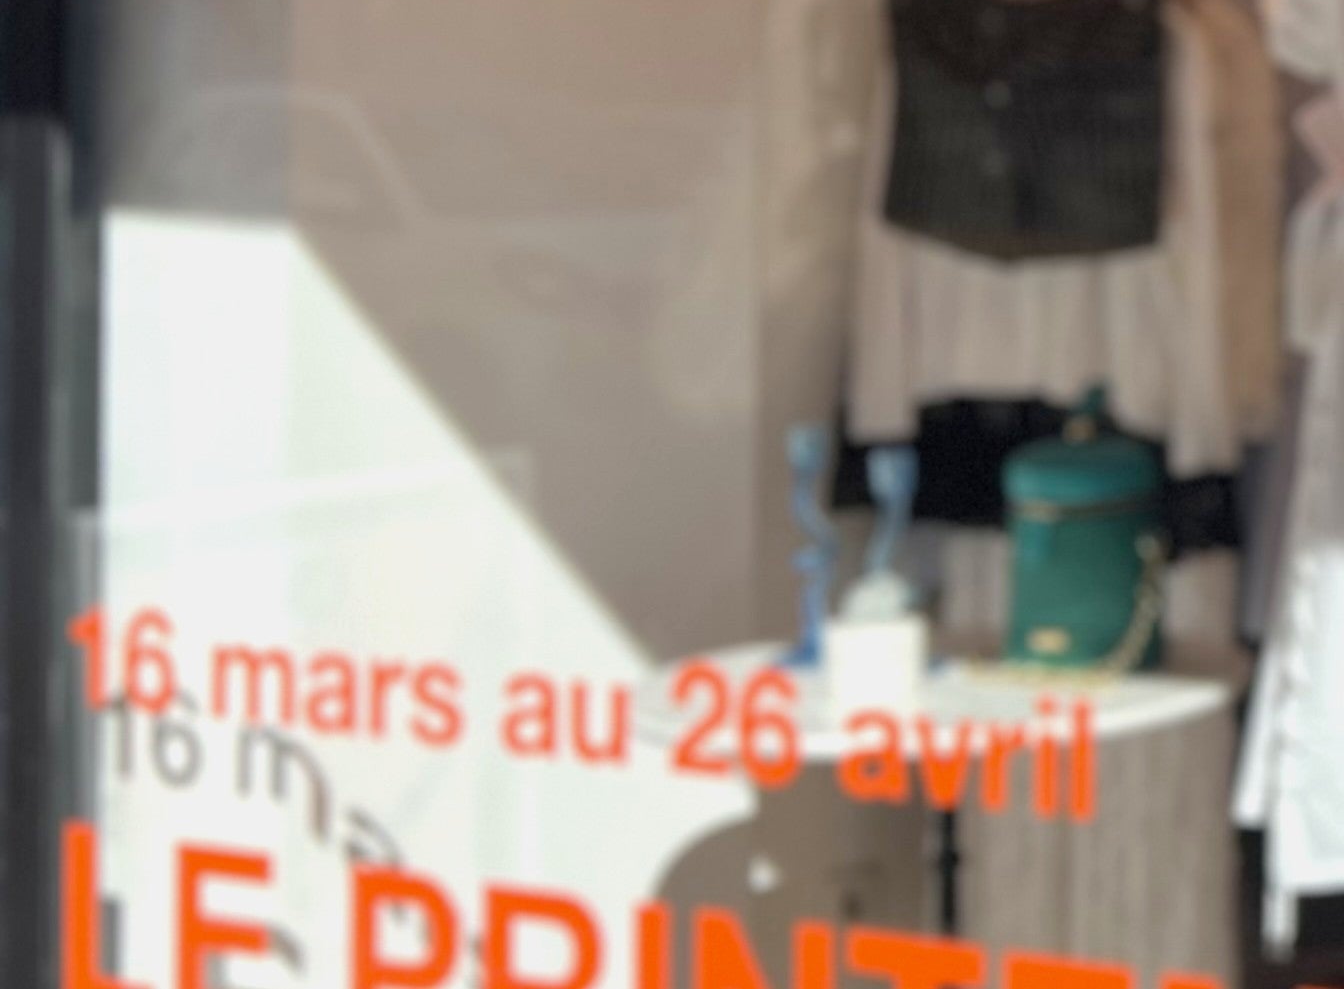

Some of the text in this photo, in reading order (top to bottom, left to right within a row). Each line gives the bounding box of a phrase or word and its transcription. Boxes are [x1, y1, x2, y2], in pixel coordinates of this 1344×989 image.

[66, 604, 1099, 826] 16 mars au 26 avril
[61, 819, 272, 989] LE
